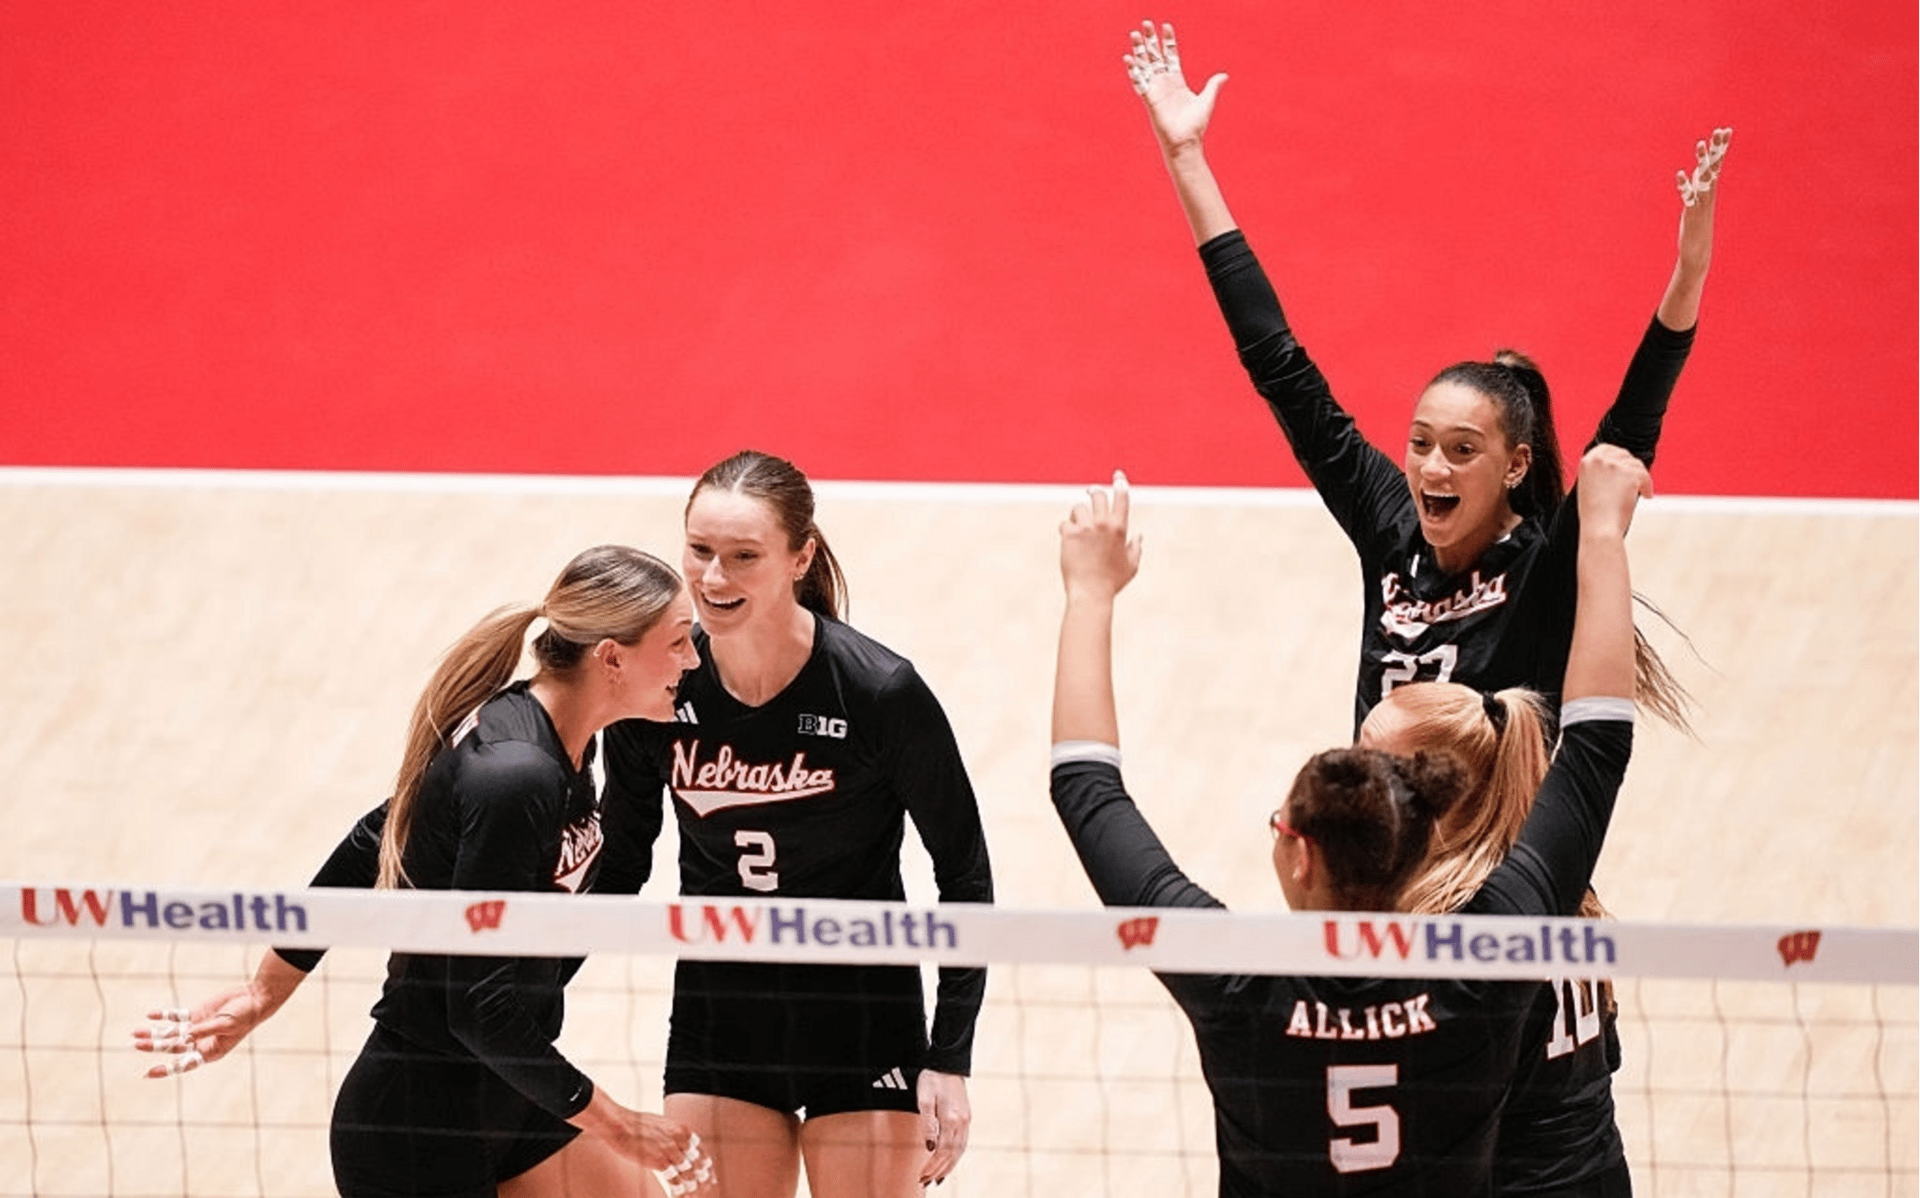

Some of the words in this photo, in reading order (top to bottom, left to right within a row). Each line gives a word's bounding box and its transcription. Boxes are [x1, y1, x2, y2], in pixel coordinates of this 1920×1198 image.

[1381, 644, 1458, 699] 27
[671, 738, 835, 794] Nebraska
[734, 829, 779, 892] 2
[1285, 992, 1437, 1041] ALLICK
[1326, 1063, 1400, 1174] 5
